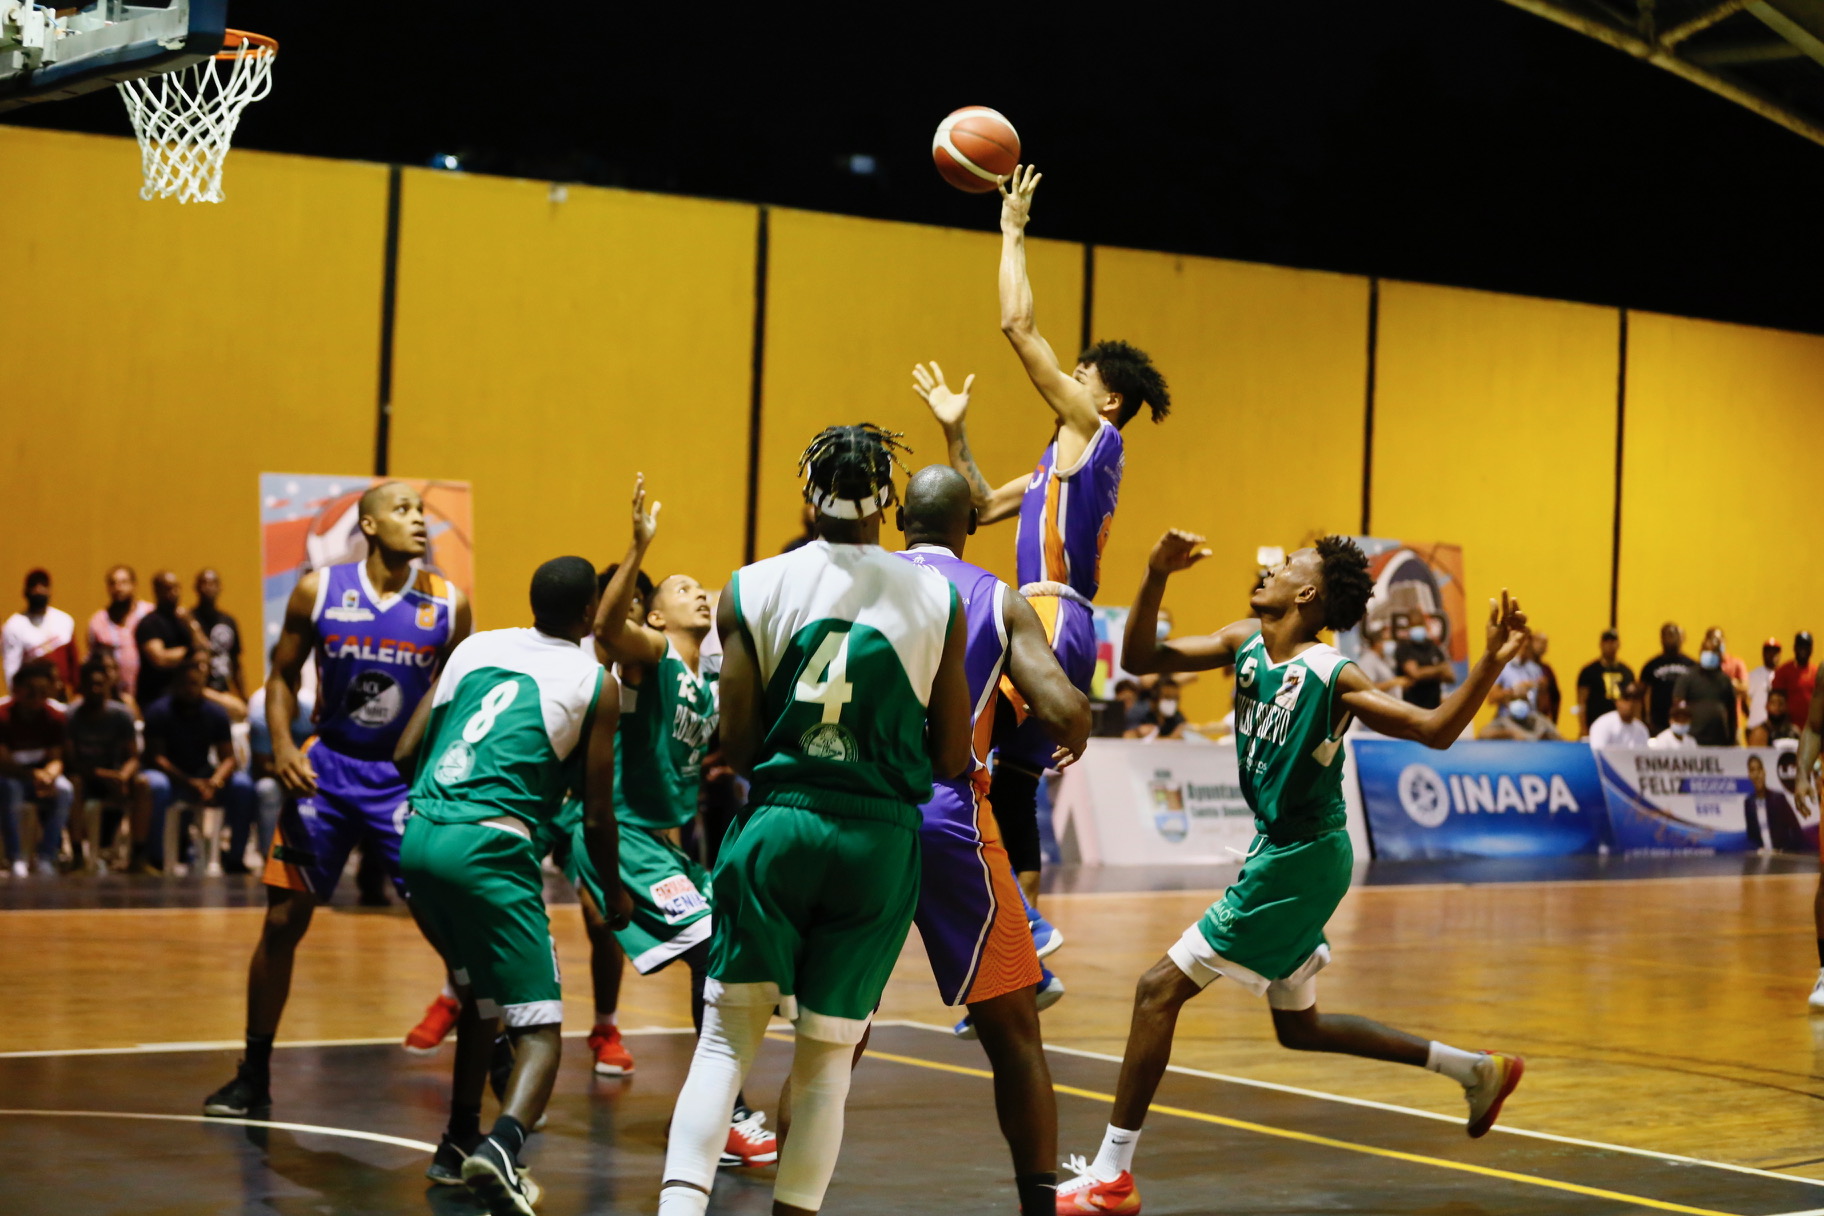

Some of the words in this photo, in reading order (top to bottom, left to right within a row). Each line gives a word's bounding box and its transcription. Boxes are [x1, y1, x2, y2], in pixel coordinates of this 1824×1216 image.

[415, 602, 438, 631] 8
[323, 634, 436, 668] CALERO
[795, 630, 853, 724] 4
[1238, 656, 1258, 689] 5
[462, 679, 519, 744] 8
[1634, 755, 1724, 774] ENMANUEL
[1449, 773, 1580, 814] INAPA
